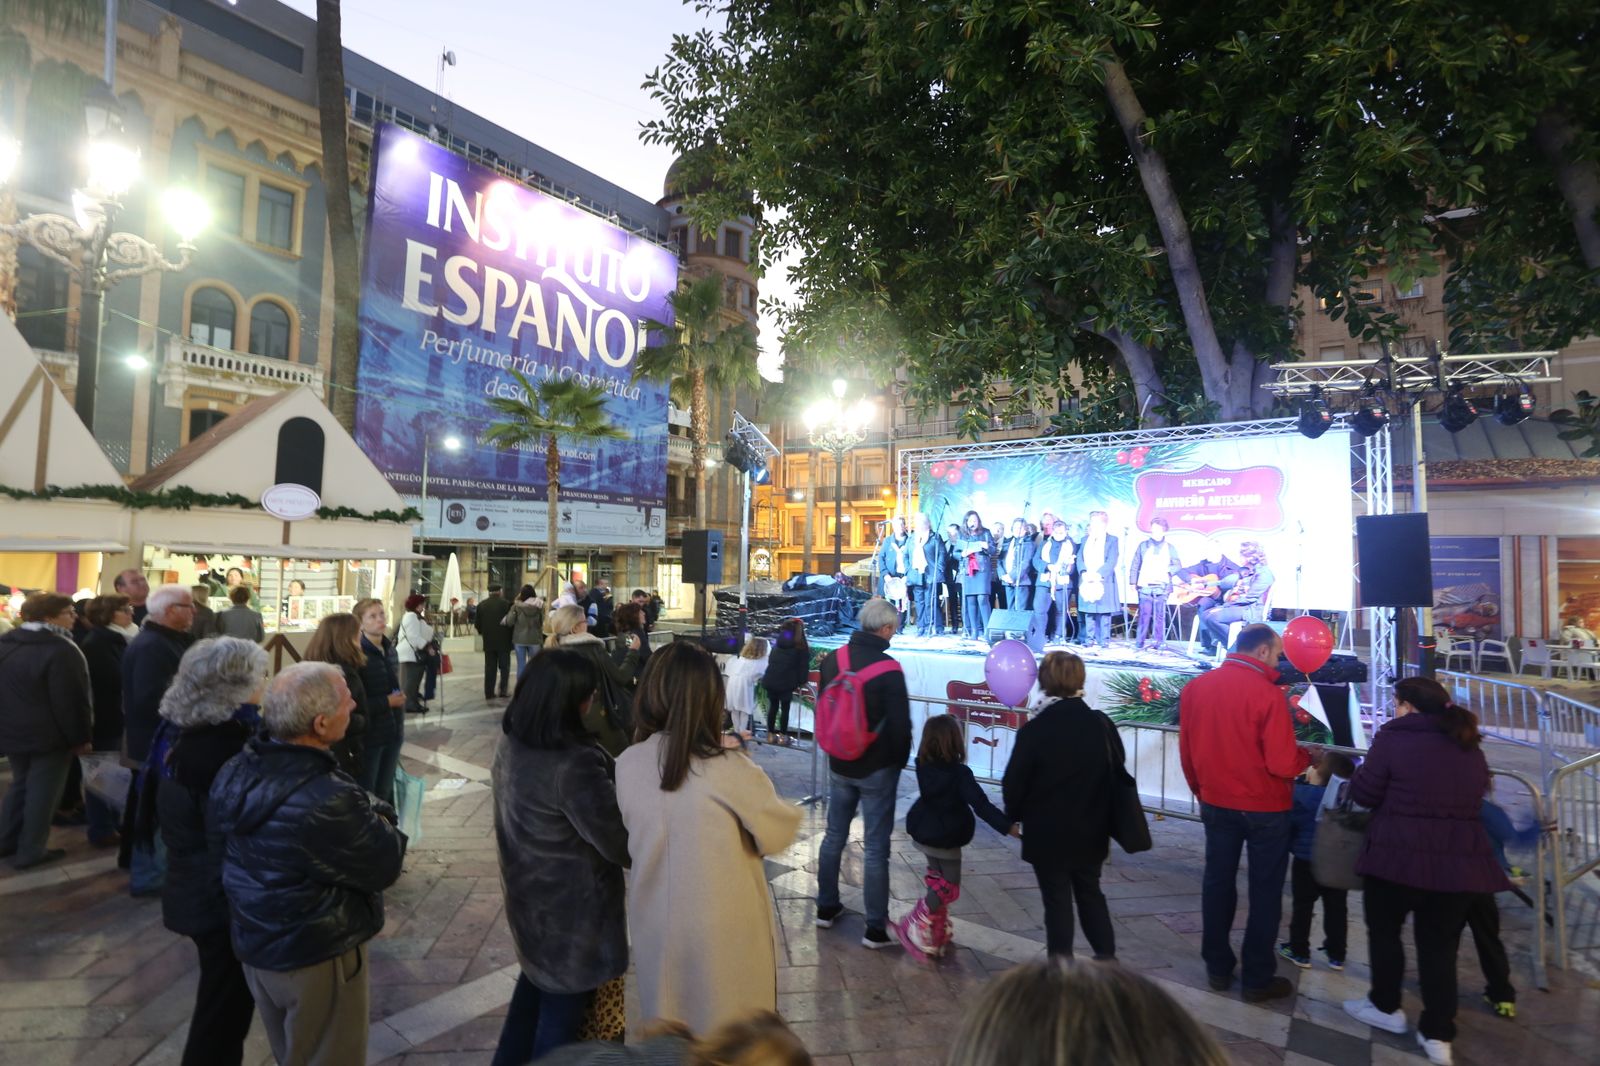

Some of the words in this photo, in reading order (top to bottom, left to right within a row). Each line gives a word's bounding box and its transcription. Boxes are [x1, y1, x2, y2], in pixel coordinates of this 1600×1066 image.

[426, 171, 651, 303] INSUTO
[419, 329, 537, 376] Perfumería
[543, 363, 555, 383] y
[558, 365, 641, 401] Cosmética
[496, 483, 507, 491] DE
[1182, 478, 1231, 487] MERCADO
